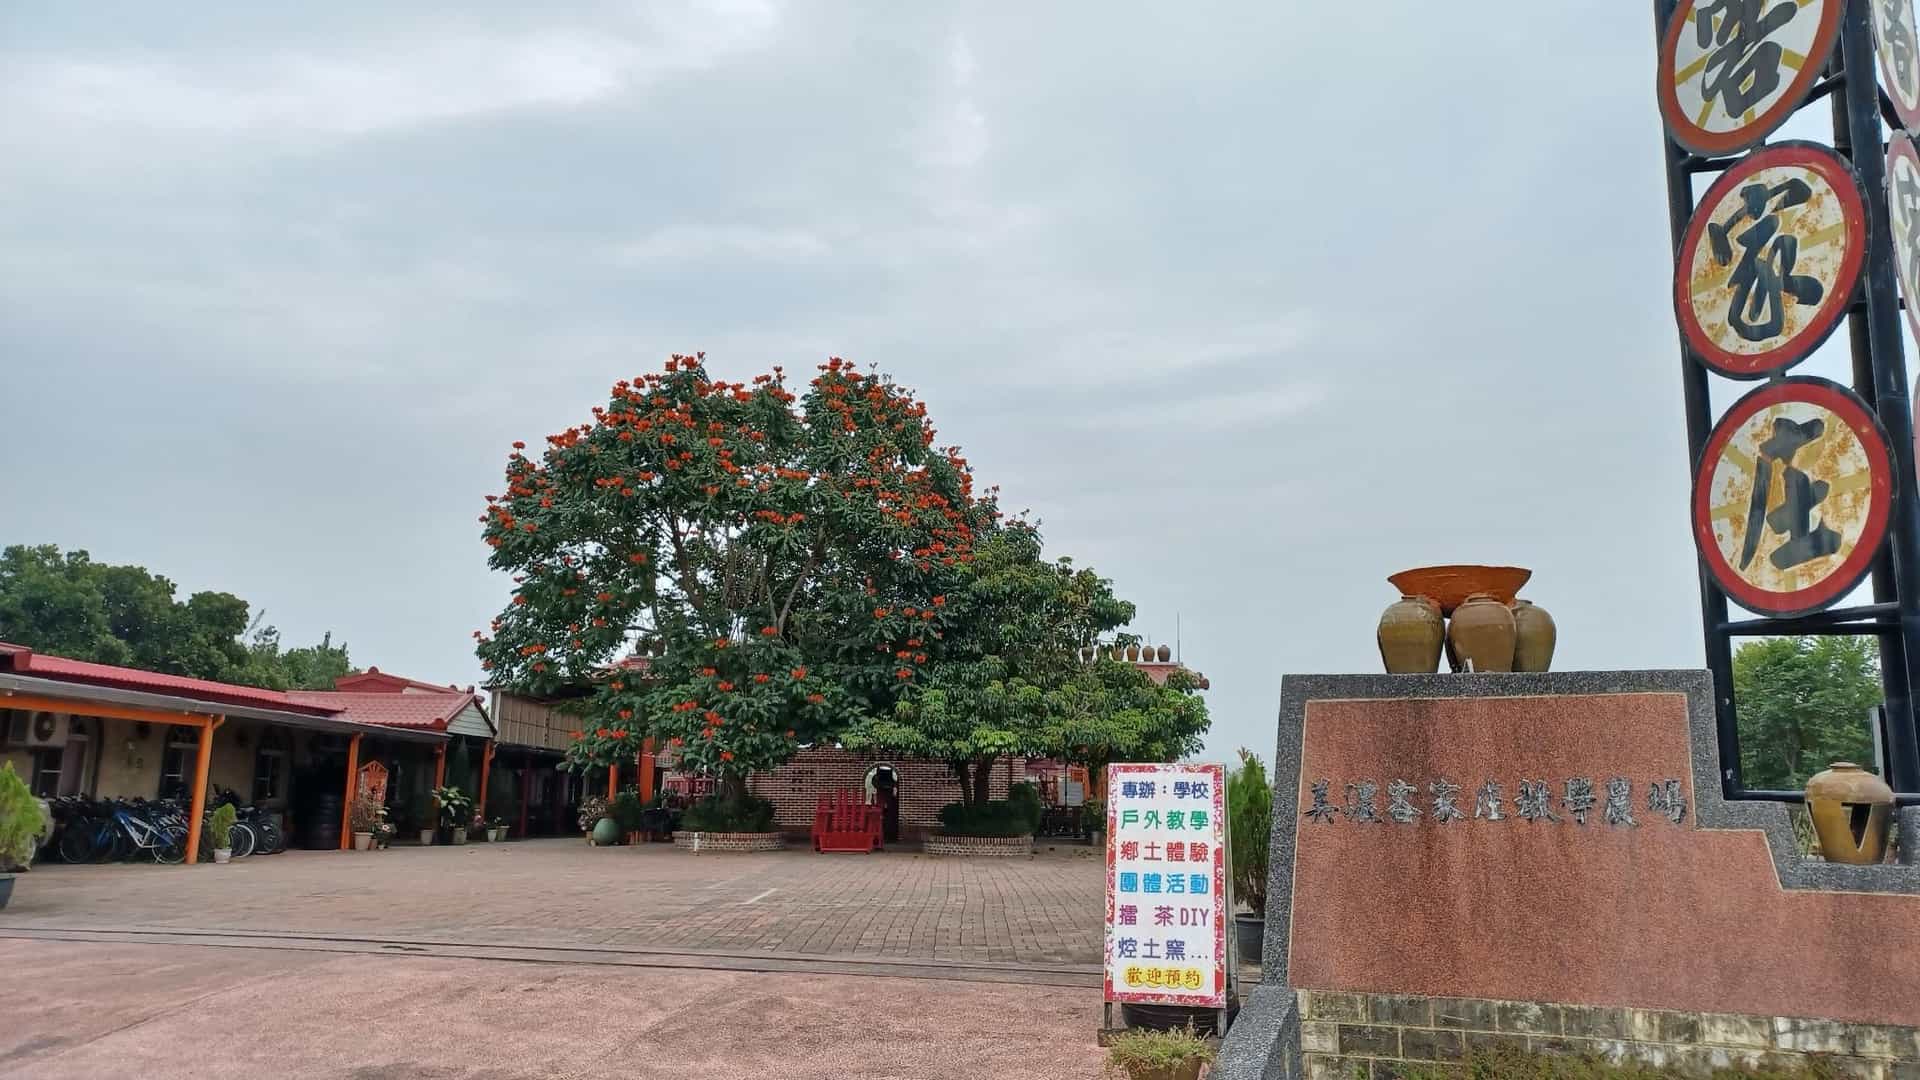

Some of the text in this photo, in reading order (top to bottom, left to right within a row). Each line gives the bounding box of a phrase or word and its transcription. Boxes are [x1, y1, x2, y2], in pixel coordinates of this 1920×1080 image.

[1121, 809, 1209, 830] 戶外教學
[1120, 841, 1209, 862] 鄉土體驗
[1120, 872, 1209, 894] 團體活動
[1127, 967, 1200, 986] 歡迎預約
